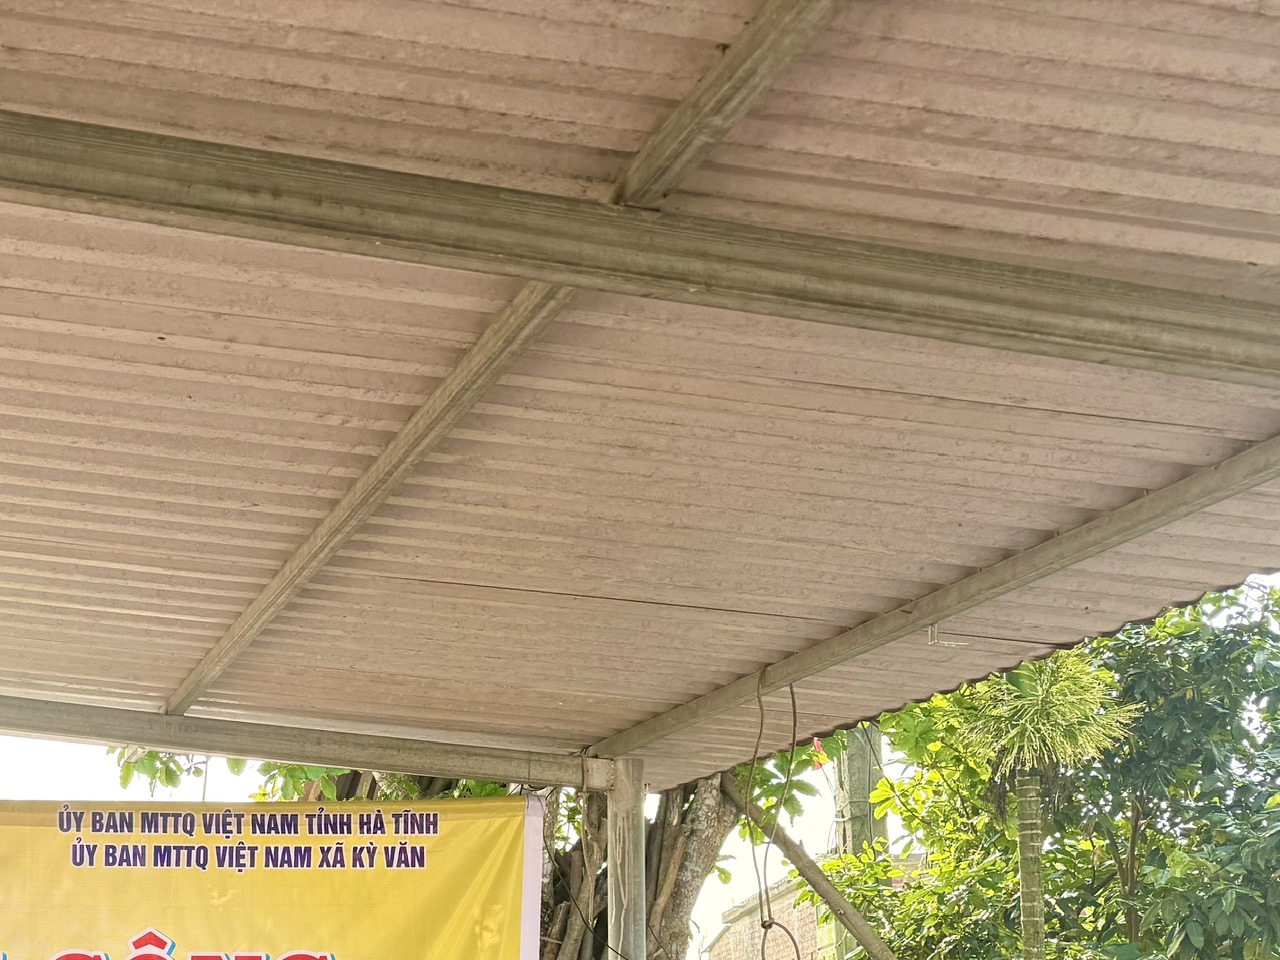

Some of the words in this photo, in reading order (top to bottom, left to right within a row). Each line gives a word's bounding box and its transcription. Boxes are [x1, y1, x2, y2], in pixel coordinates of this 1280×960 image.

[58, 804, 85, 833] ỦY
[91, 811, 134, 833] BAN
[140, 812, 195, 837] MTTQ
[202, 808, 245, 839] VIỆT
[251, 813, 299, 835] NAM
[305, 807, 352, 835] TỈNH
[359, 809, 386, 835] HÀ
[391, 809, 438, 835] TĨNH
[72, 836, 98, 867] ỦY
[104, 845, 146, 867] BAN
[153, 845, 209, 871] MTTQ
[215, 841, 259, 873] VIỆT
[264, 845, 312, 868] NAM
[318, 841, 346, 868] XÃ
[352, 841, 378, 868] KỲ
[383, 841, 425, 868] VĂN
